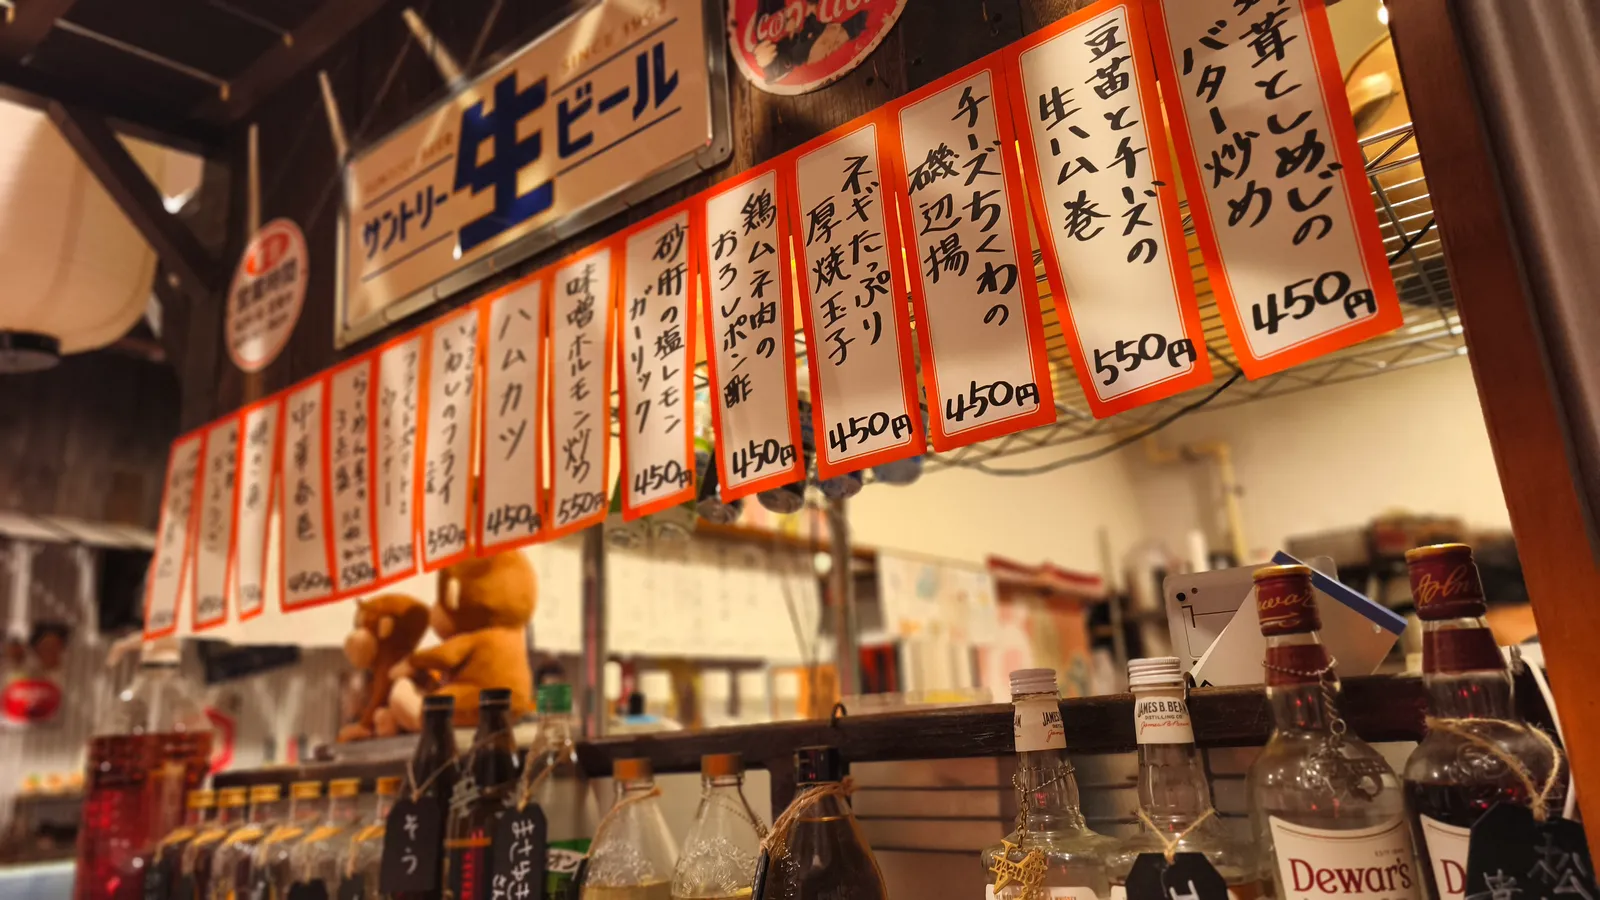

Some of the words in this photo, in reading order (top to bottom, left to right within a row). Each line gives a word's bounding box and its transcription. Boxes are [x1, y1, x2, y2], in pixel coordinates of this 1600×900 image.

[363, 185, 449, 259] サントリー
[453, 69, 555, 254] 生
[557, 41, 679, 160] ビール
[1039, 86, 1111, 242] 生ハム巻
[1085, 18, 1166, 264] 豆苗とチーズの
[1183, 20, 1273, 228] バター炒め
[740, 188, 777, 359] 鶏ムネ肉の
[806, 195, 856, 367] 厚焼玉子
[841, 155, 891, 345] ネギたっぷり
[908, 142, 969, 284] 磯辺揚
[951, 86, 1018, 326] チーズちくわの
[630, 284, 652, 434] ガーリック
[652, 222, 690, 434] 砂肝の塩レモン
[711, 231, 753, 409] おろしポン酢
[1093, 333, 1197, 385] 550円
[1252, 270, 1378, 335] 450円
[498, 308, 532, 461] ハムカツ
[732, 439, 797, 478] 450円
[829, 411, 913, 453] 450円
[946, 380, 1040, 422] 450円
[486, 504, 542, 536] 450円
[556, 491, 607, 524] 550円
[634, 460, 693, 495] 450円
[401, 814, 420, 875] そう
[1288, 858, 1412, 894] Dewar's
